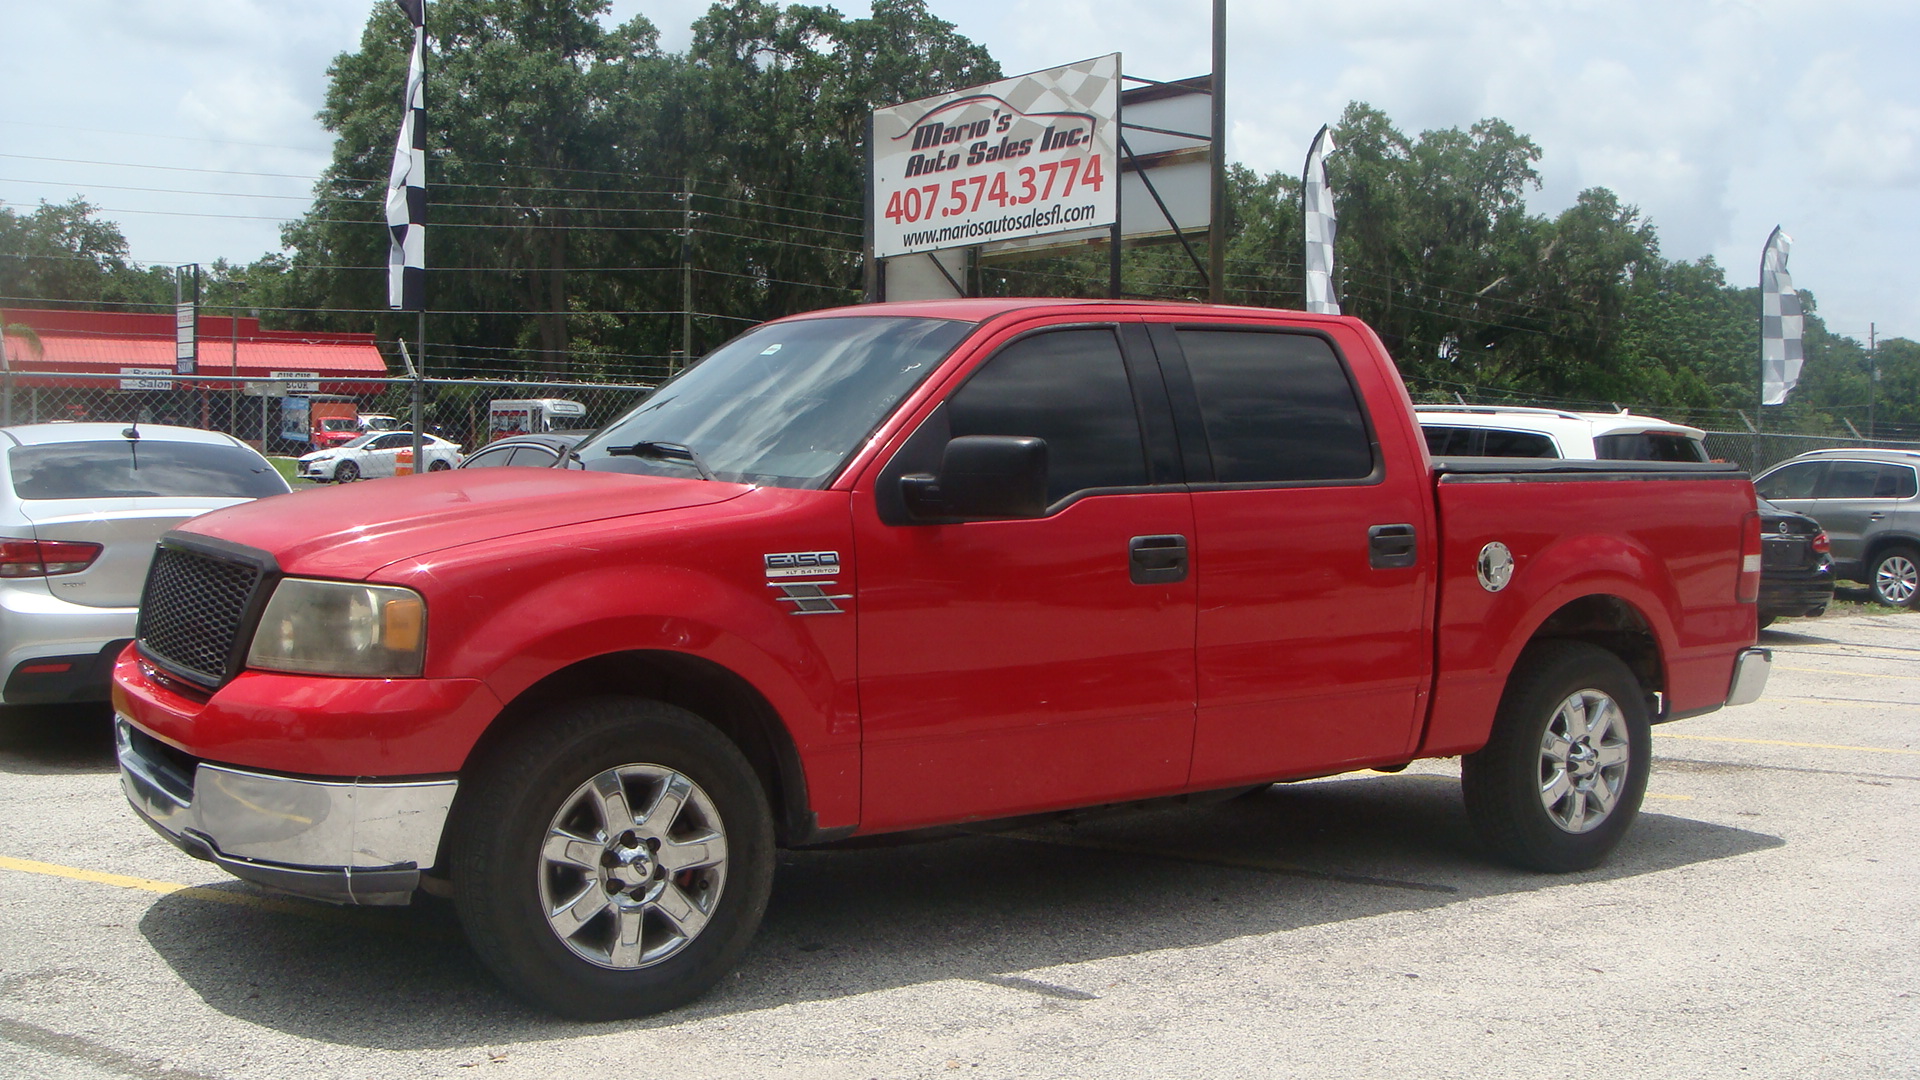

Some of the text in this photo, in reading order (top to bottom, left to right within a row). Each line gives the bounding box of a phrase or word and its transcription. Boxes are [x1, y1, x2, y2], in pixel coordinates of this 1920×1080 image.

[911, 109, 1012, 151] Mario's
[905, 126, 1090, 178] Auto Sales Inc.
[885, 154, 1103, 225] 407.574.3774
[903, 204, 1095, 247] www.mariosautosalesfl.com
[138, 380, 171, 389] Salon
